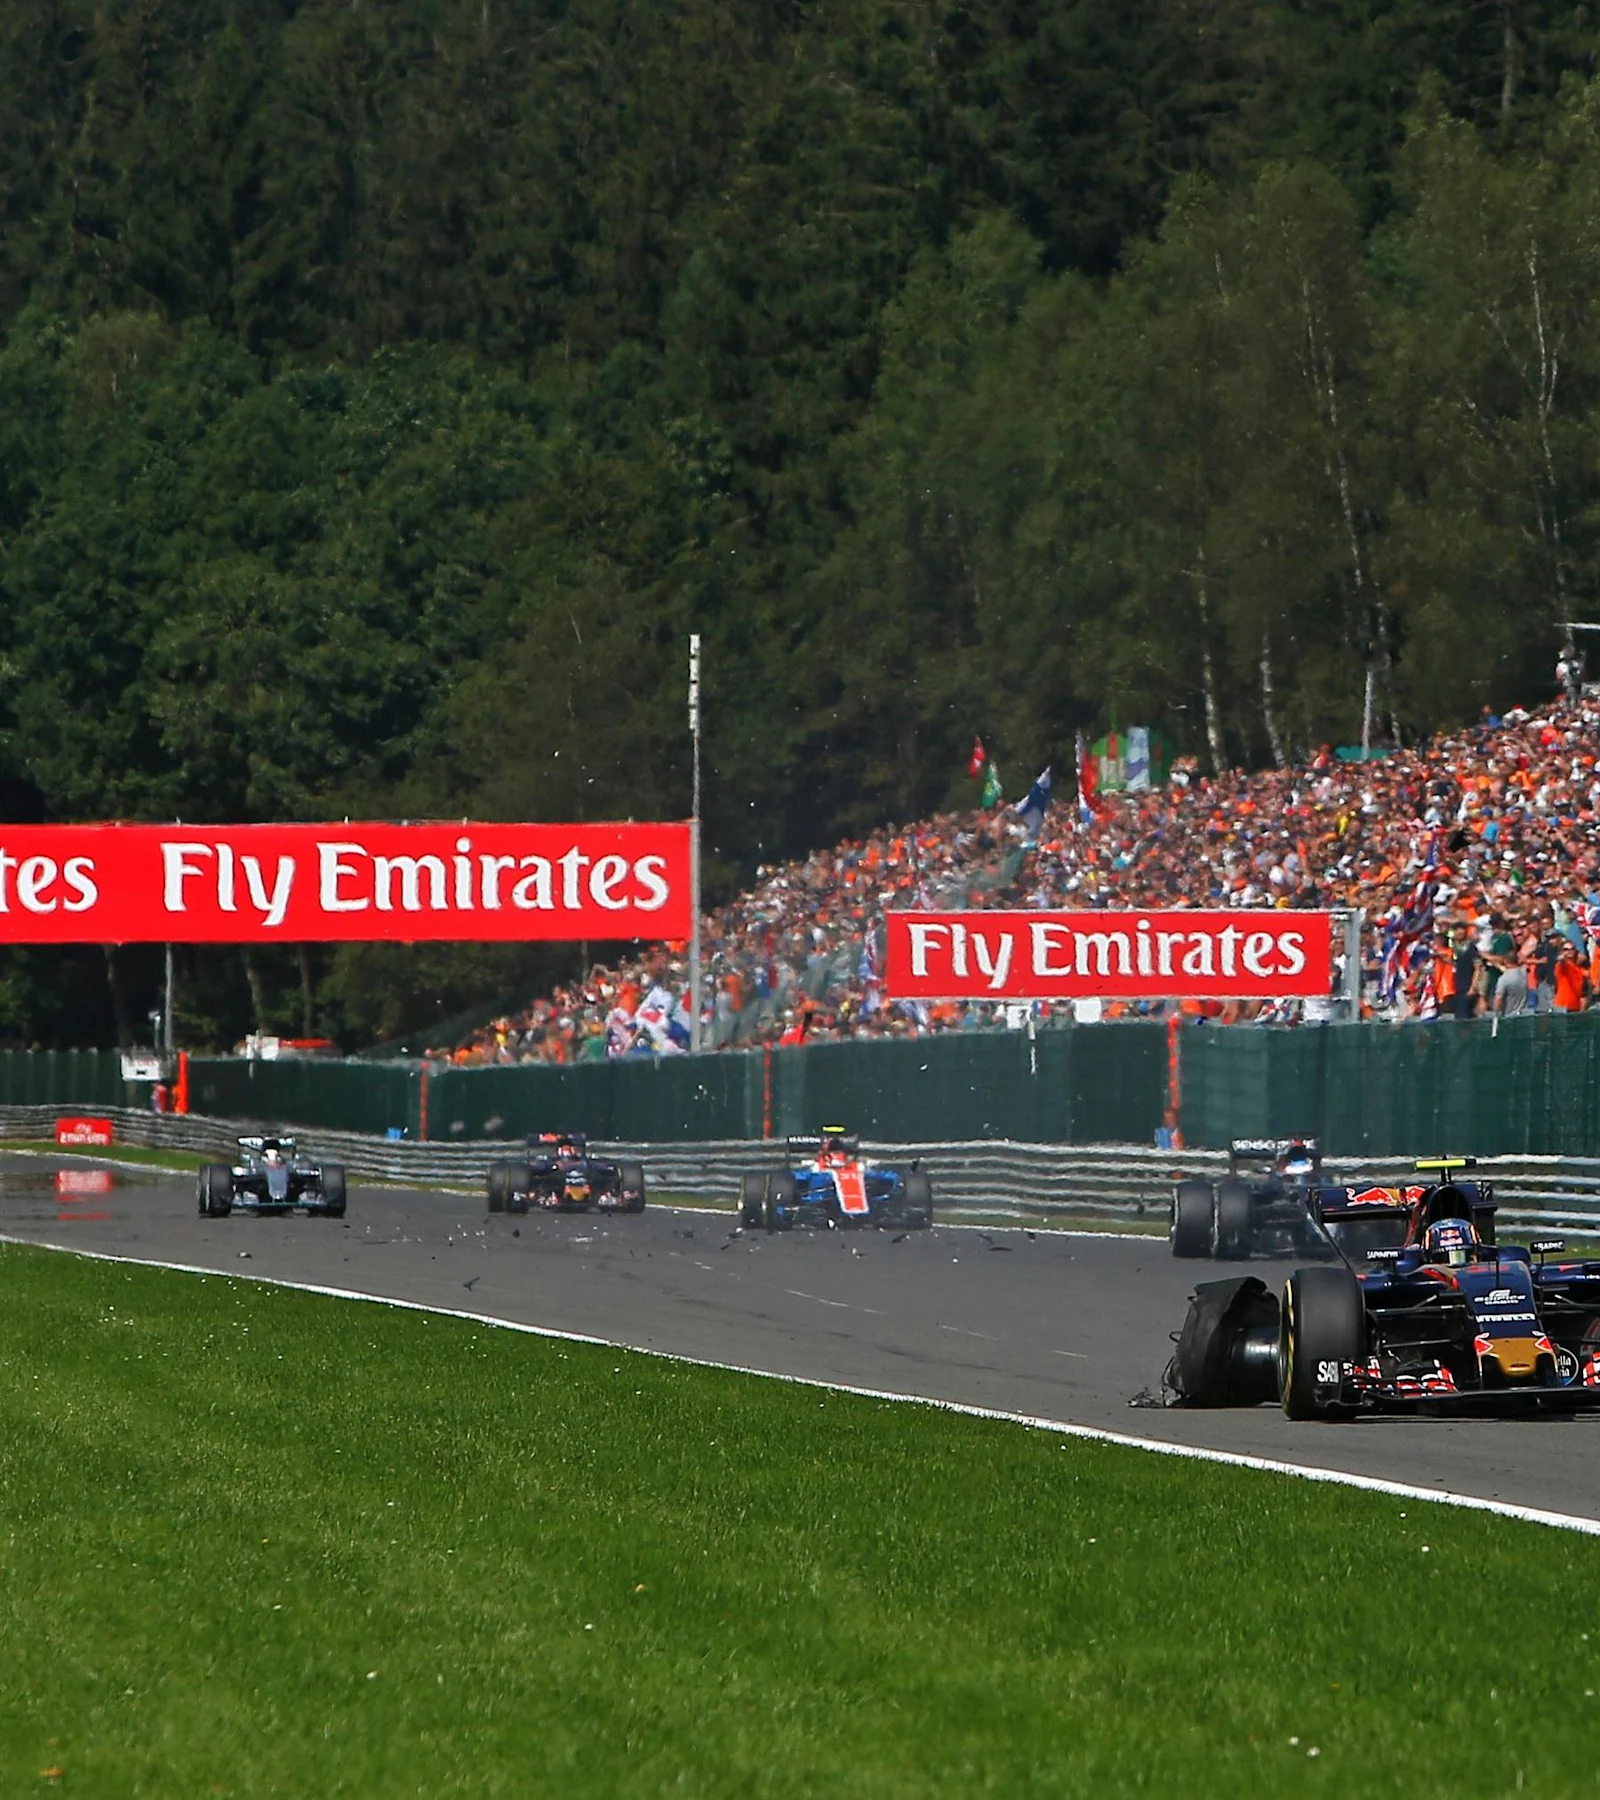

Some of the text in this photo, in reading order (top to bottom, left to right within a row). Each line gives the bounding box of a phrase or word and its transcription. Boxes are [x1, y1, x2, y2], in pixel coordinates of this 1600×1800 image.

[161, 842, 295, 926] Fly
[317, 837, 669, 912] Emirates
[907, 919, 1306, 989] Fly Emirates
